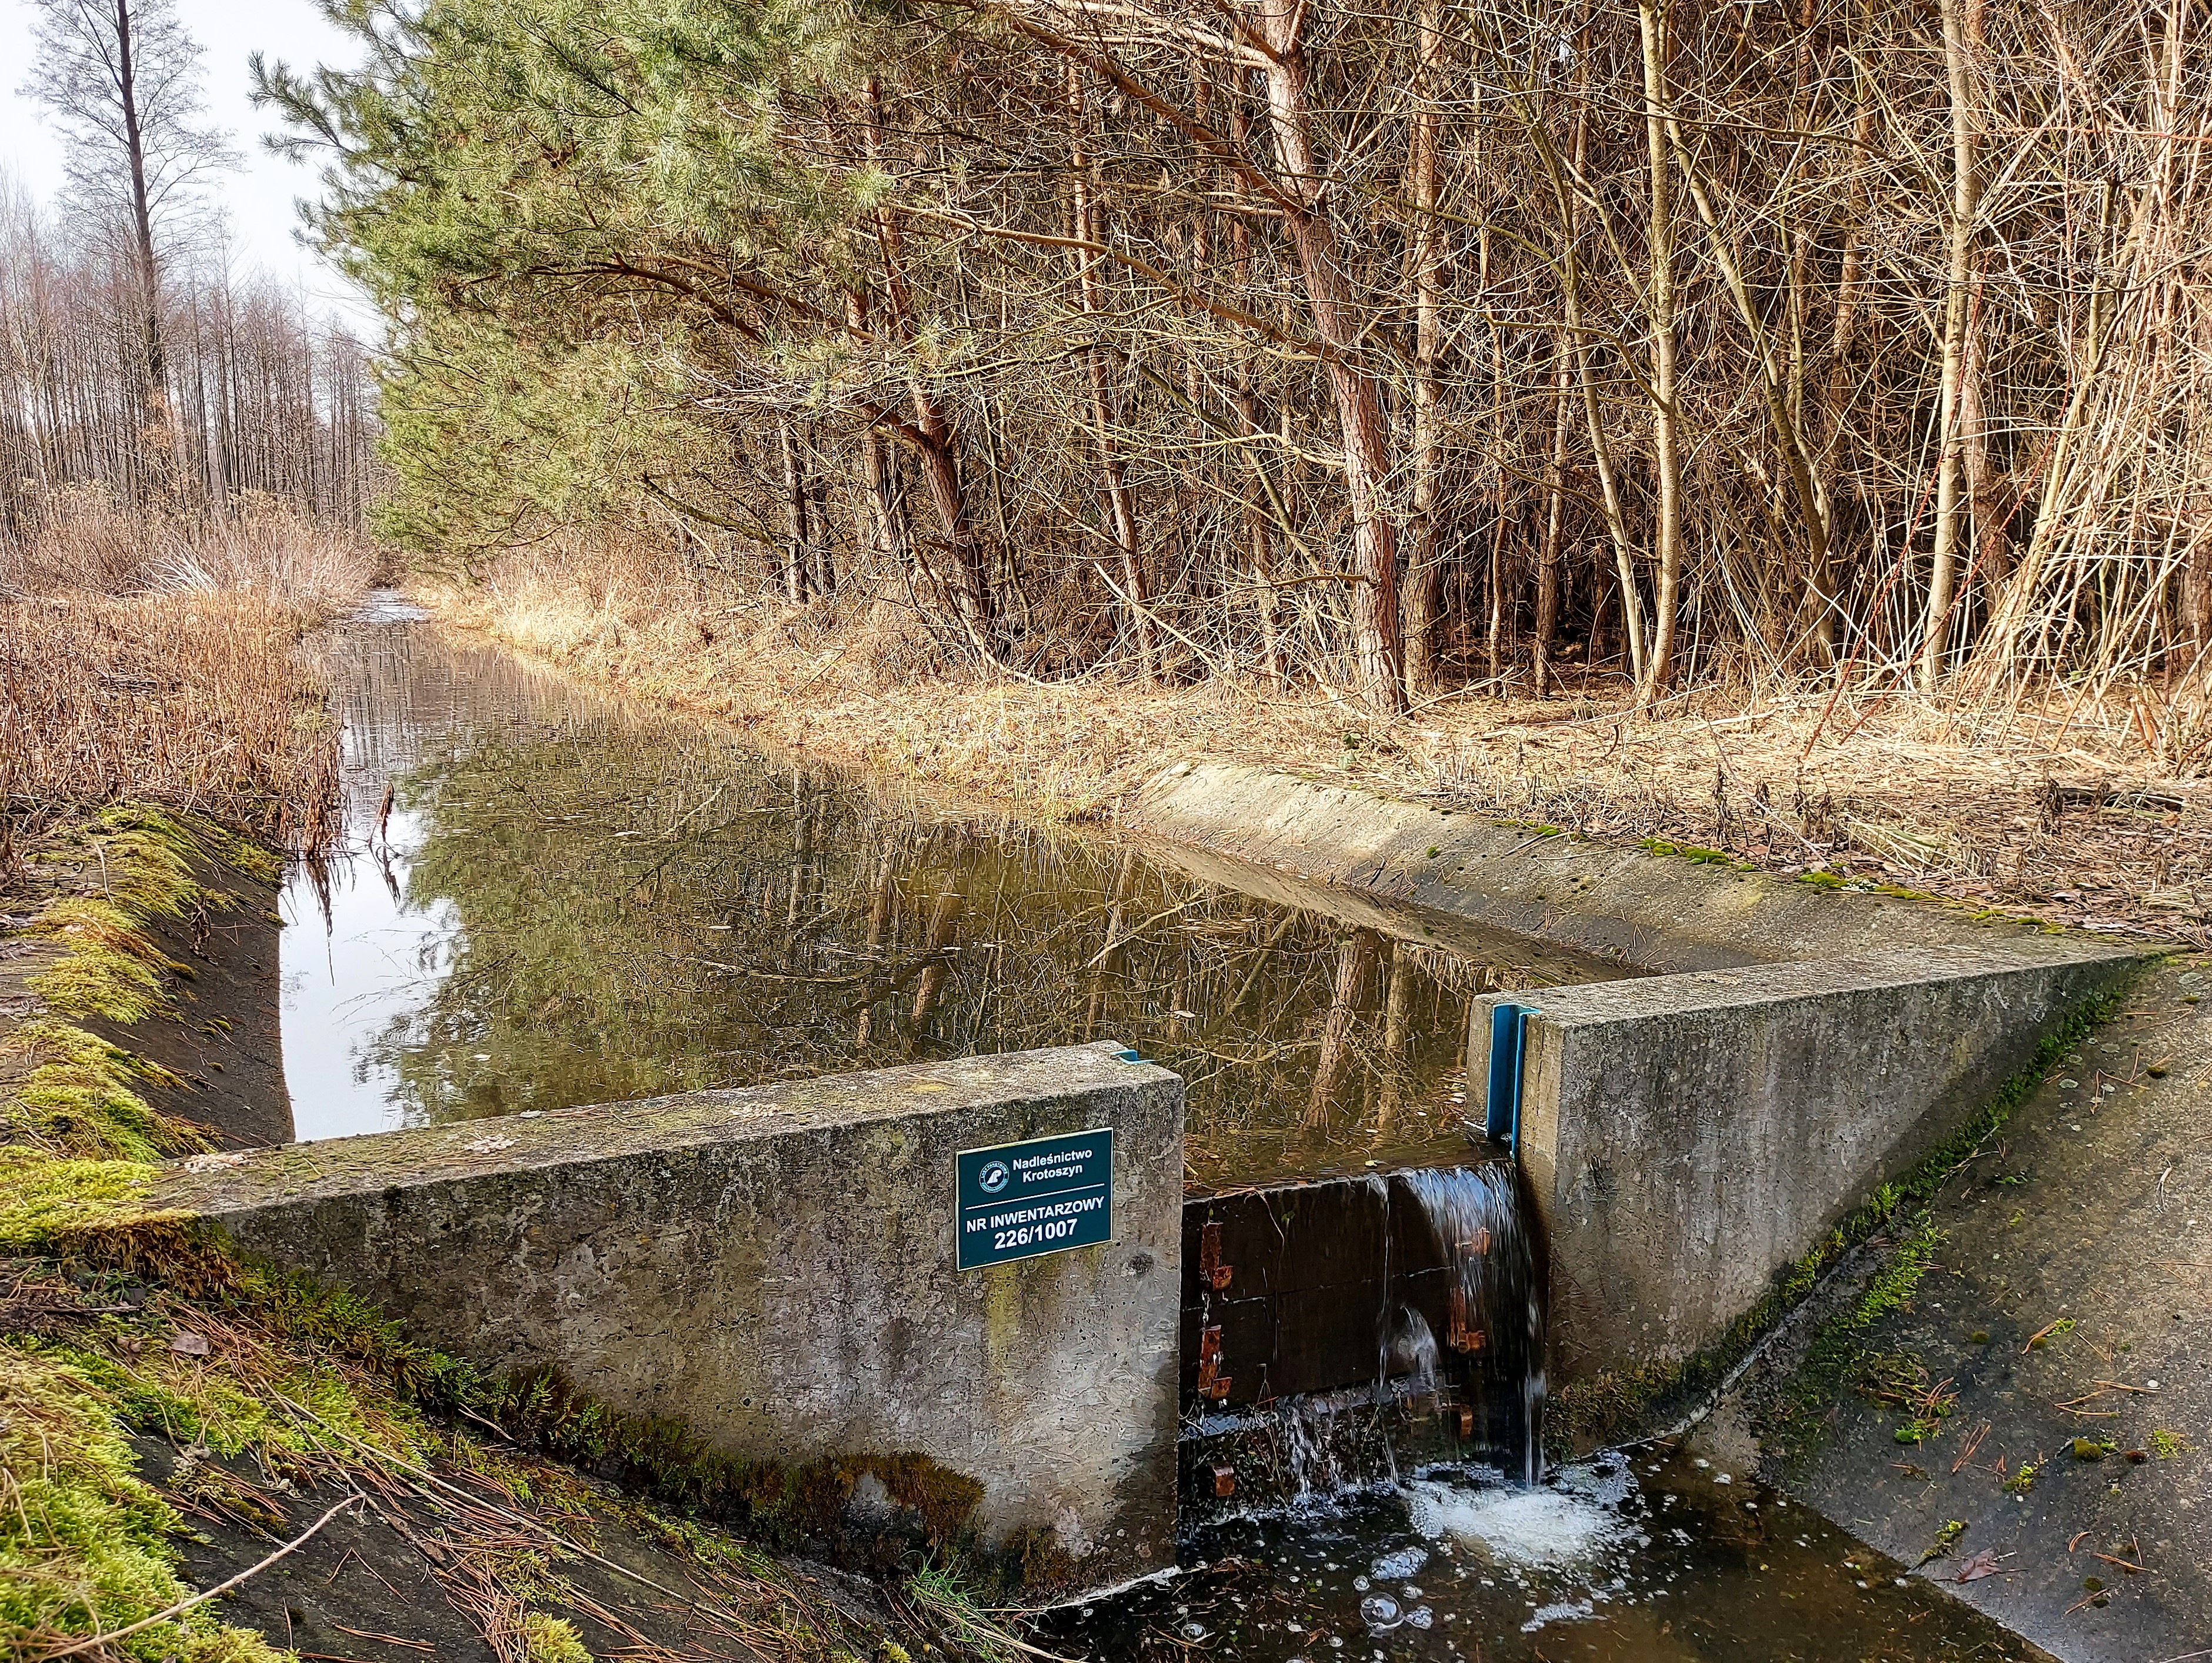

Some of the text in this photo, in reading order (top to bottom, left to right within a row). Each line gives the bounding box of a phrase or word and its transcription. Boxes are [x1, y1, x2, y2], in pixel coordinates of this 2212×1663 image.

[1013, 1150, 1092, 1171] Nadleśnictwo
[1023, 1164, 1083, 1183] Krotoszyn
[967, 1196, 1105, 1233] NR INWENTARZOWY
[994, 1218, 1078, 1250] 226/1007
